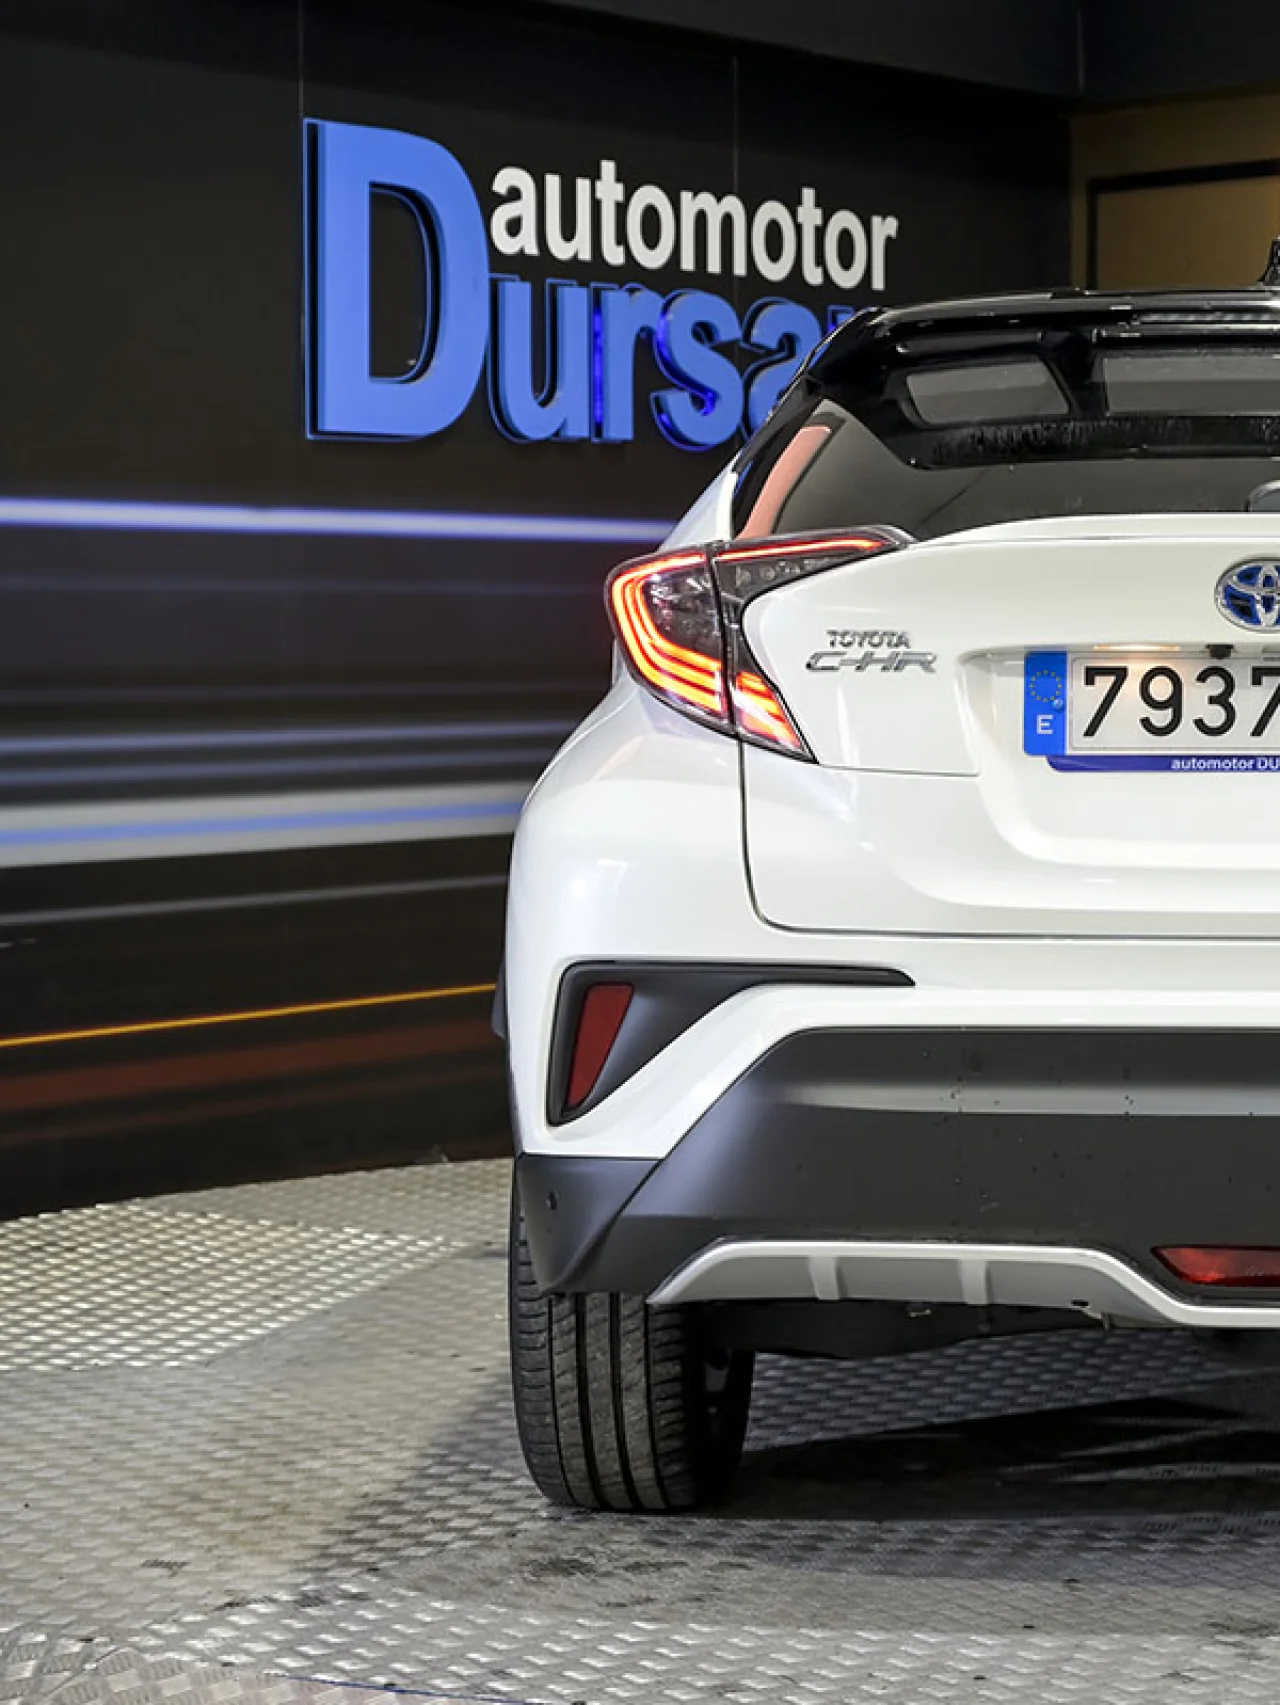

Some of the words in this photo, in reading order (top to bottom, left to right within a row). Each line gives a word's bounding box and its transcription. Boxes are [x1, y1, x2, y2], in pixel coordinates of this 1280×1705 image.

[491, 160, 898, 290] automotor
[304, 118, 856, 450] Dursa
[826, 629, 912, 649] TOYOTA
[1036, 714, 1054, 735] E
